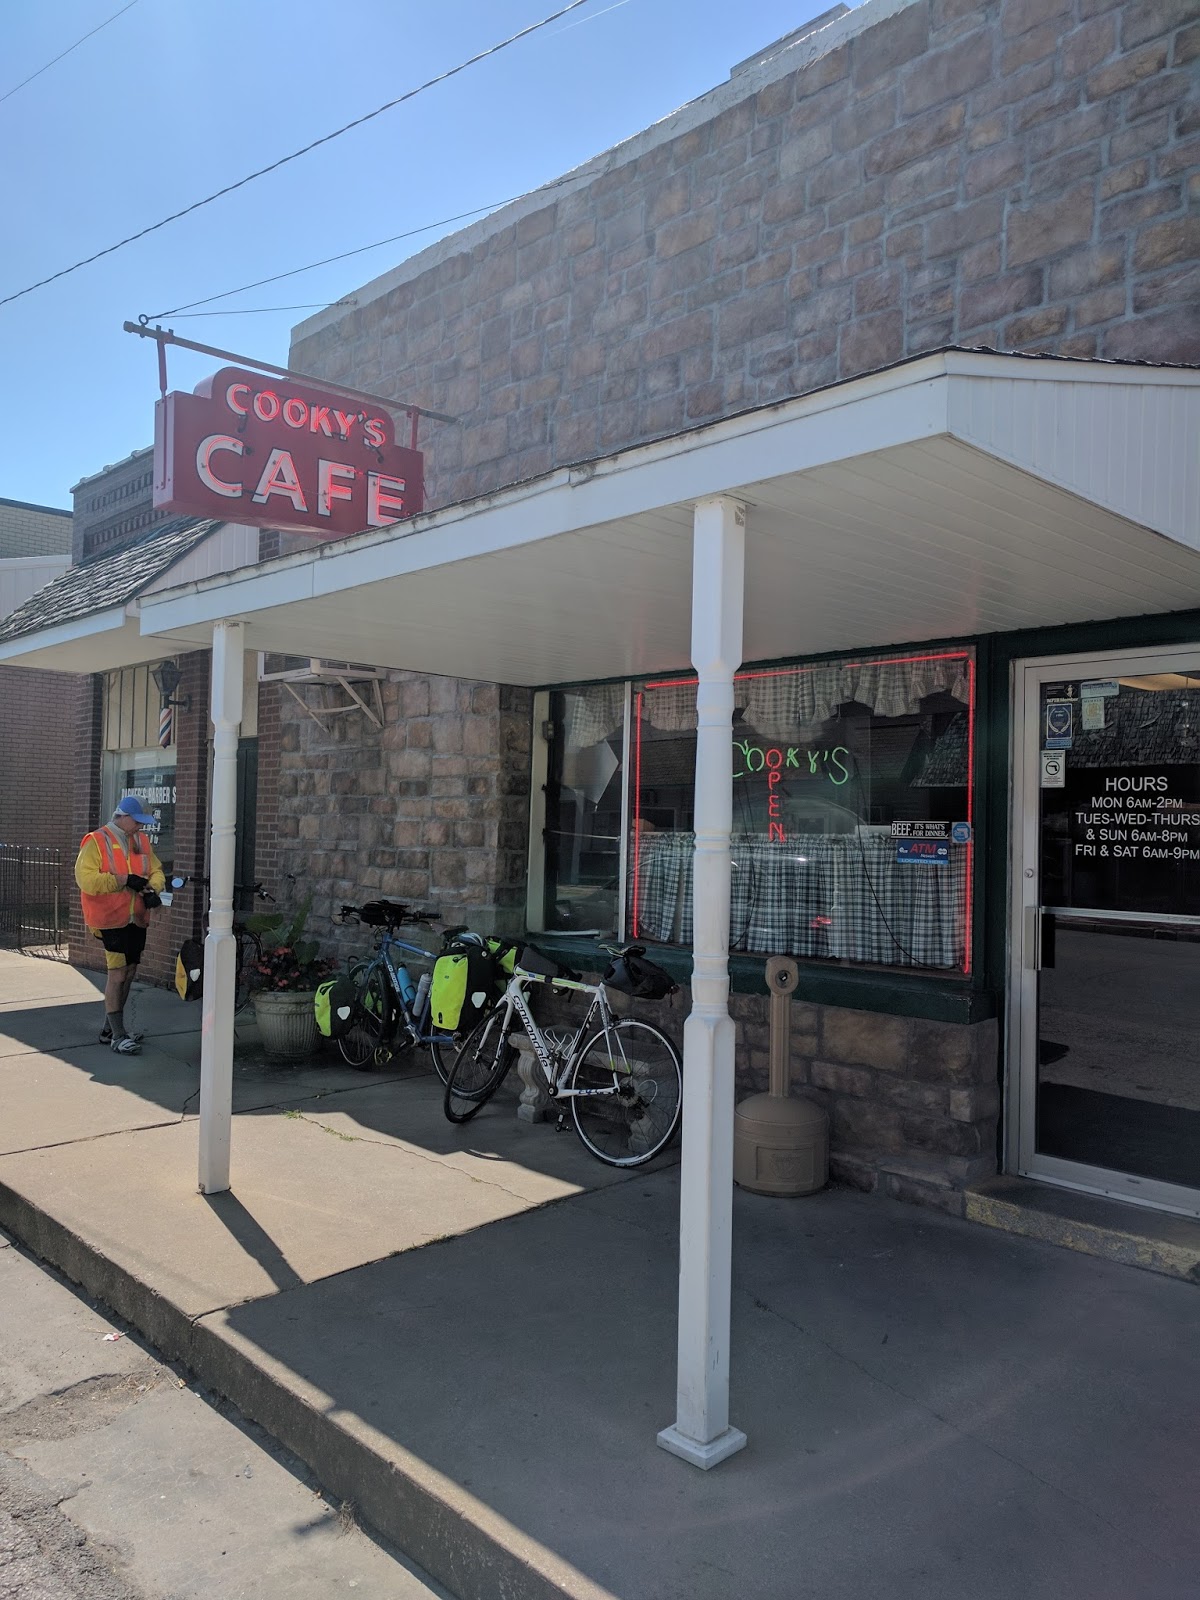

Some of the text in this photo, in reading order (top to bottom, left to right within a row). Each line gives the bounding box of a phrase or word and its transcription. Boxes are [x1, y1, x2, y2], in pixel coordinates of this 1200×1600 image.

[225, 382, 386, 449] COOKY'S
[195, 433, 406, 528] CAFE
[1105, 776, 1168, 791] HOURS
[765, 749, 786, 843] OPEN
[1091, 796, 1183, 808] MON 6AM-2PM
[1075, 812, 1200, 825] TUES-WED-THURS
[1086, 828, 1188, 842] & SUN 6AM-8PM
[910, 842, 937, 854] ATM
[1075, 844, 1200, 859] FRI & SAT 6AM-9PM
